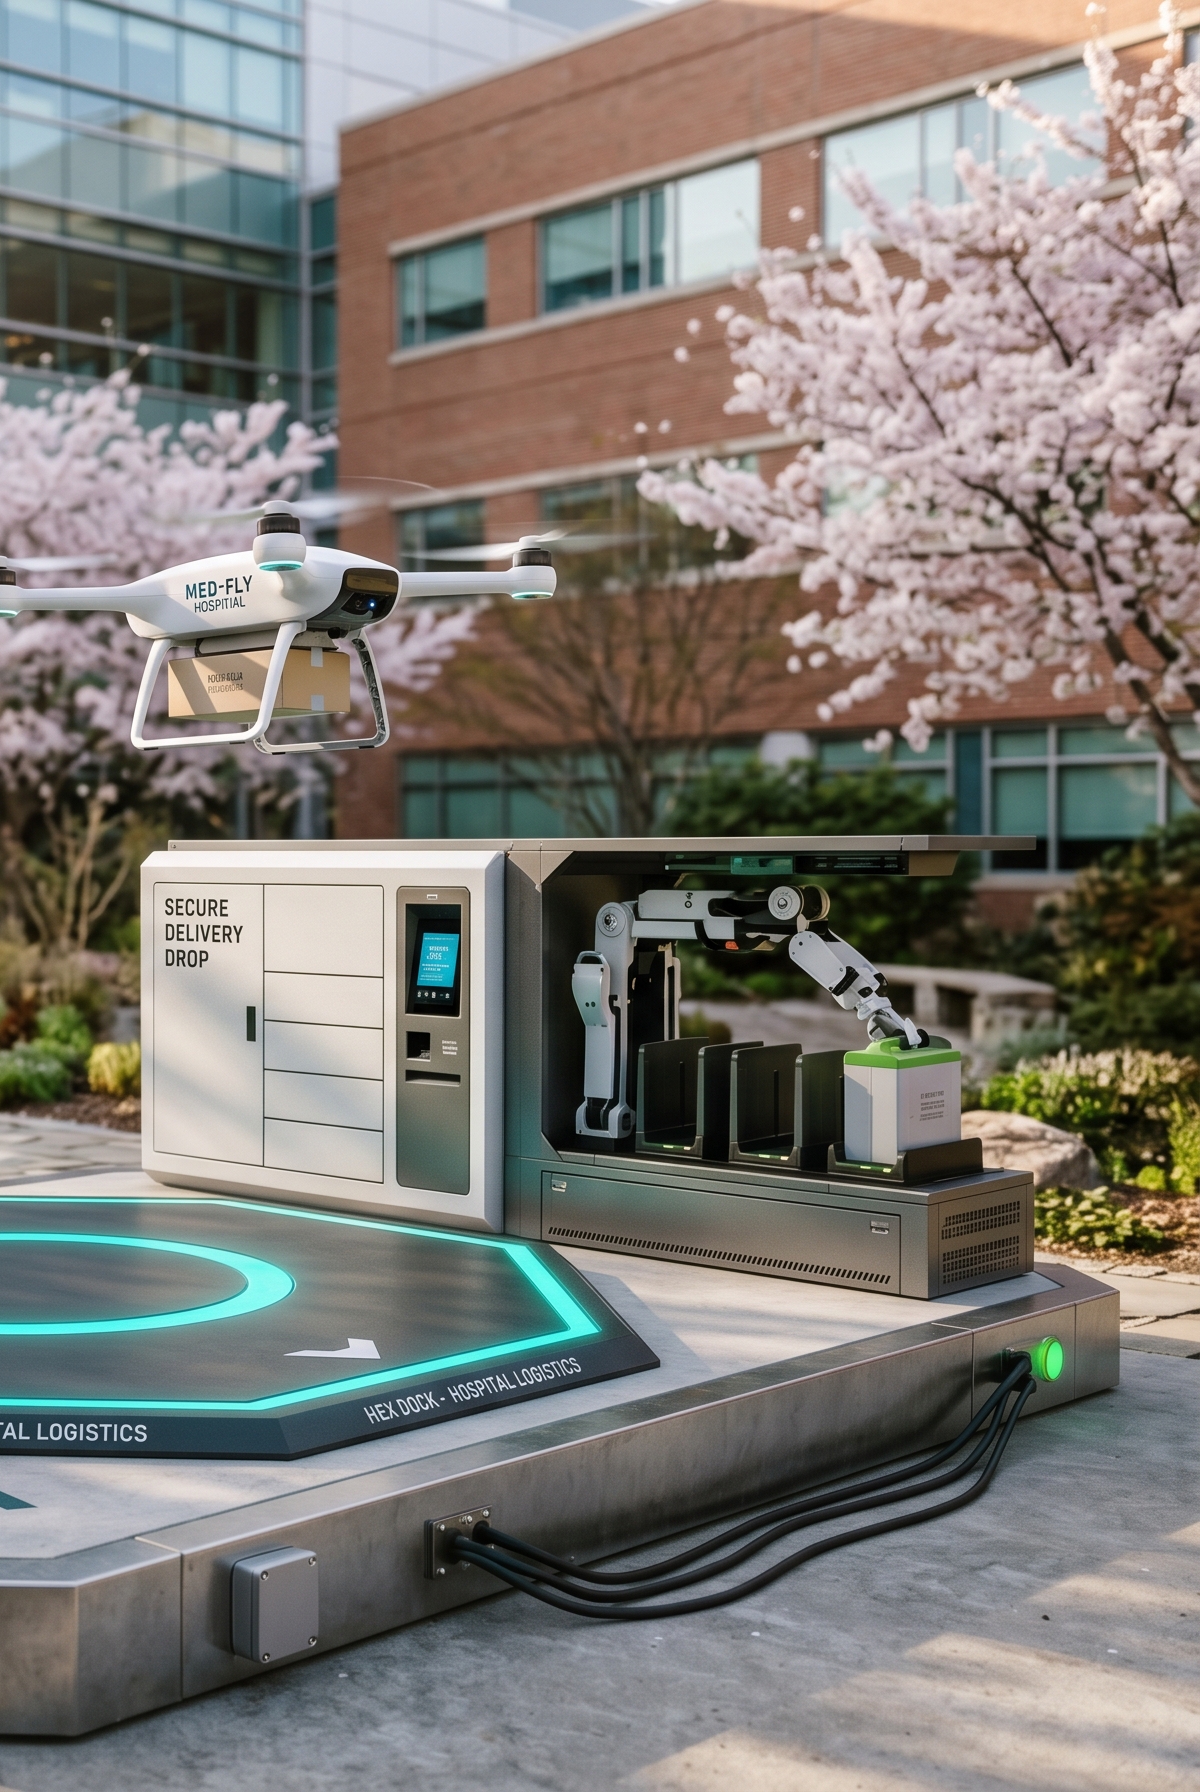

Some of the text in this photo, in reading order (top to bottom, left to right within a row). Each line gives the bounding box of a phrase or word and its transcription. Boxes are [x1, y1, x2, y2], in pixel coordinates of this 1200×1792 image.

[185, 575, 253, 600] MED-FLY
[164, 898, 229, 917] SECURE
[165, 923, 243, 943] DELIVERY
[165, 949, 209, 968] DROP
[363, 1401, 399, 1424] HEX
[397, 1391, 440, 1416] DOCK
[447, 1373, 516, 1403] HOSPITAL
[513, 1357, 582, 1387] LOGISTICS
[36, 1423, 148, 1443] LOGISTICS
